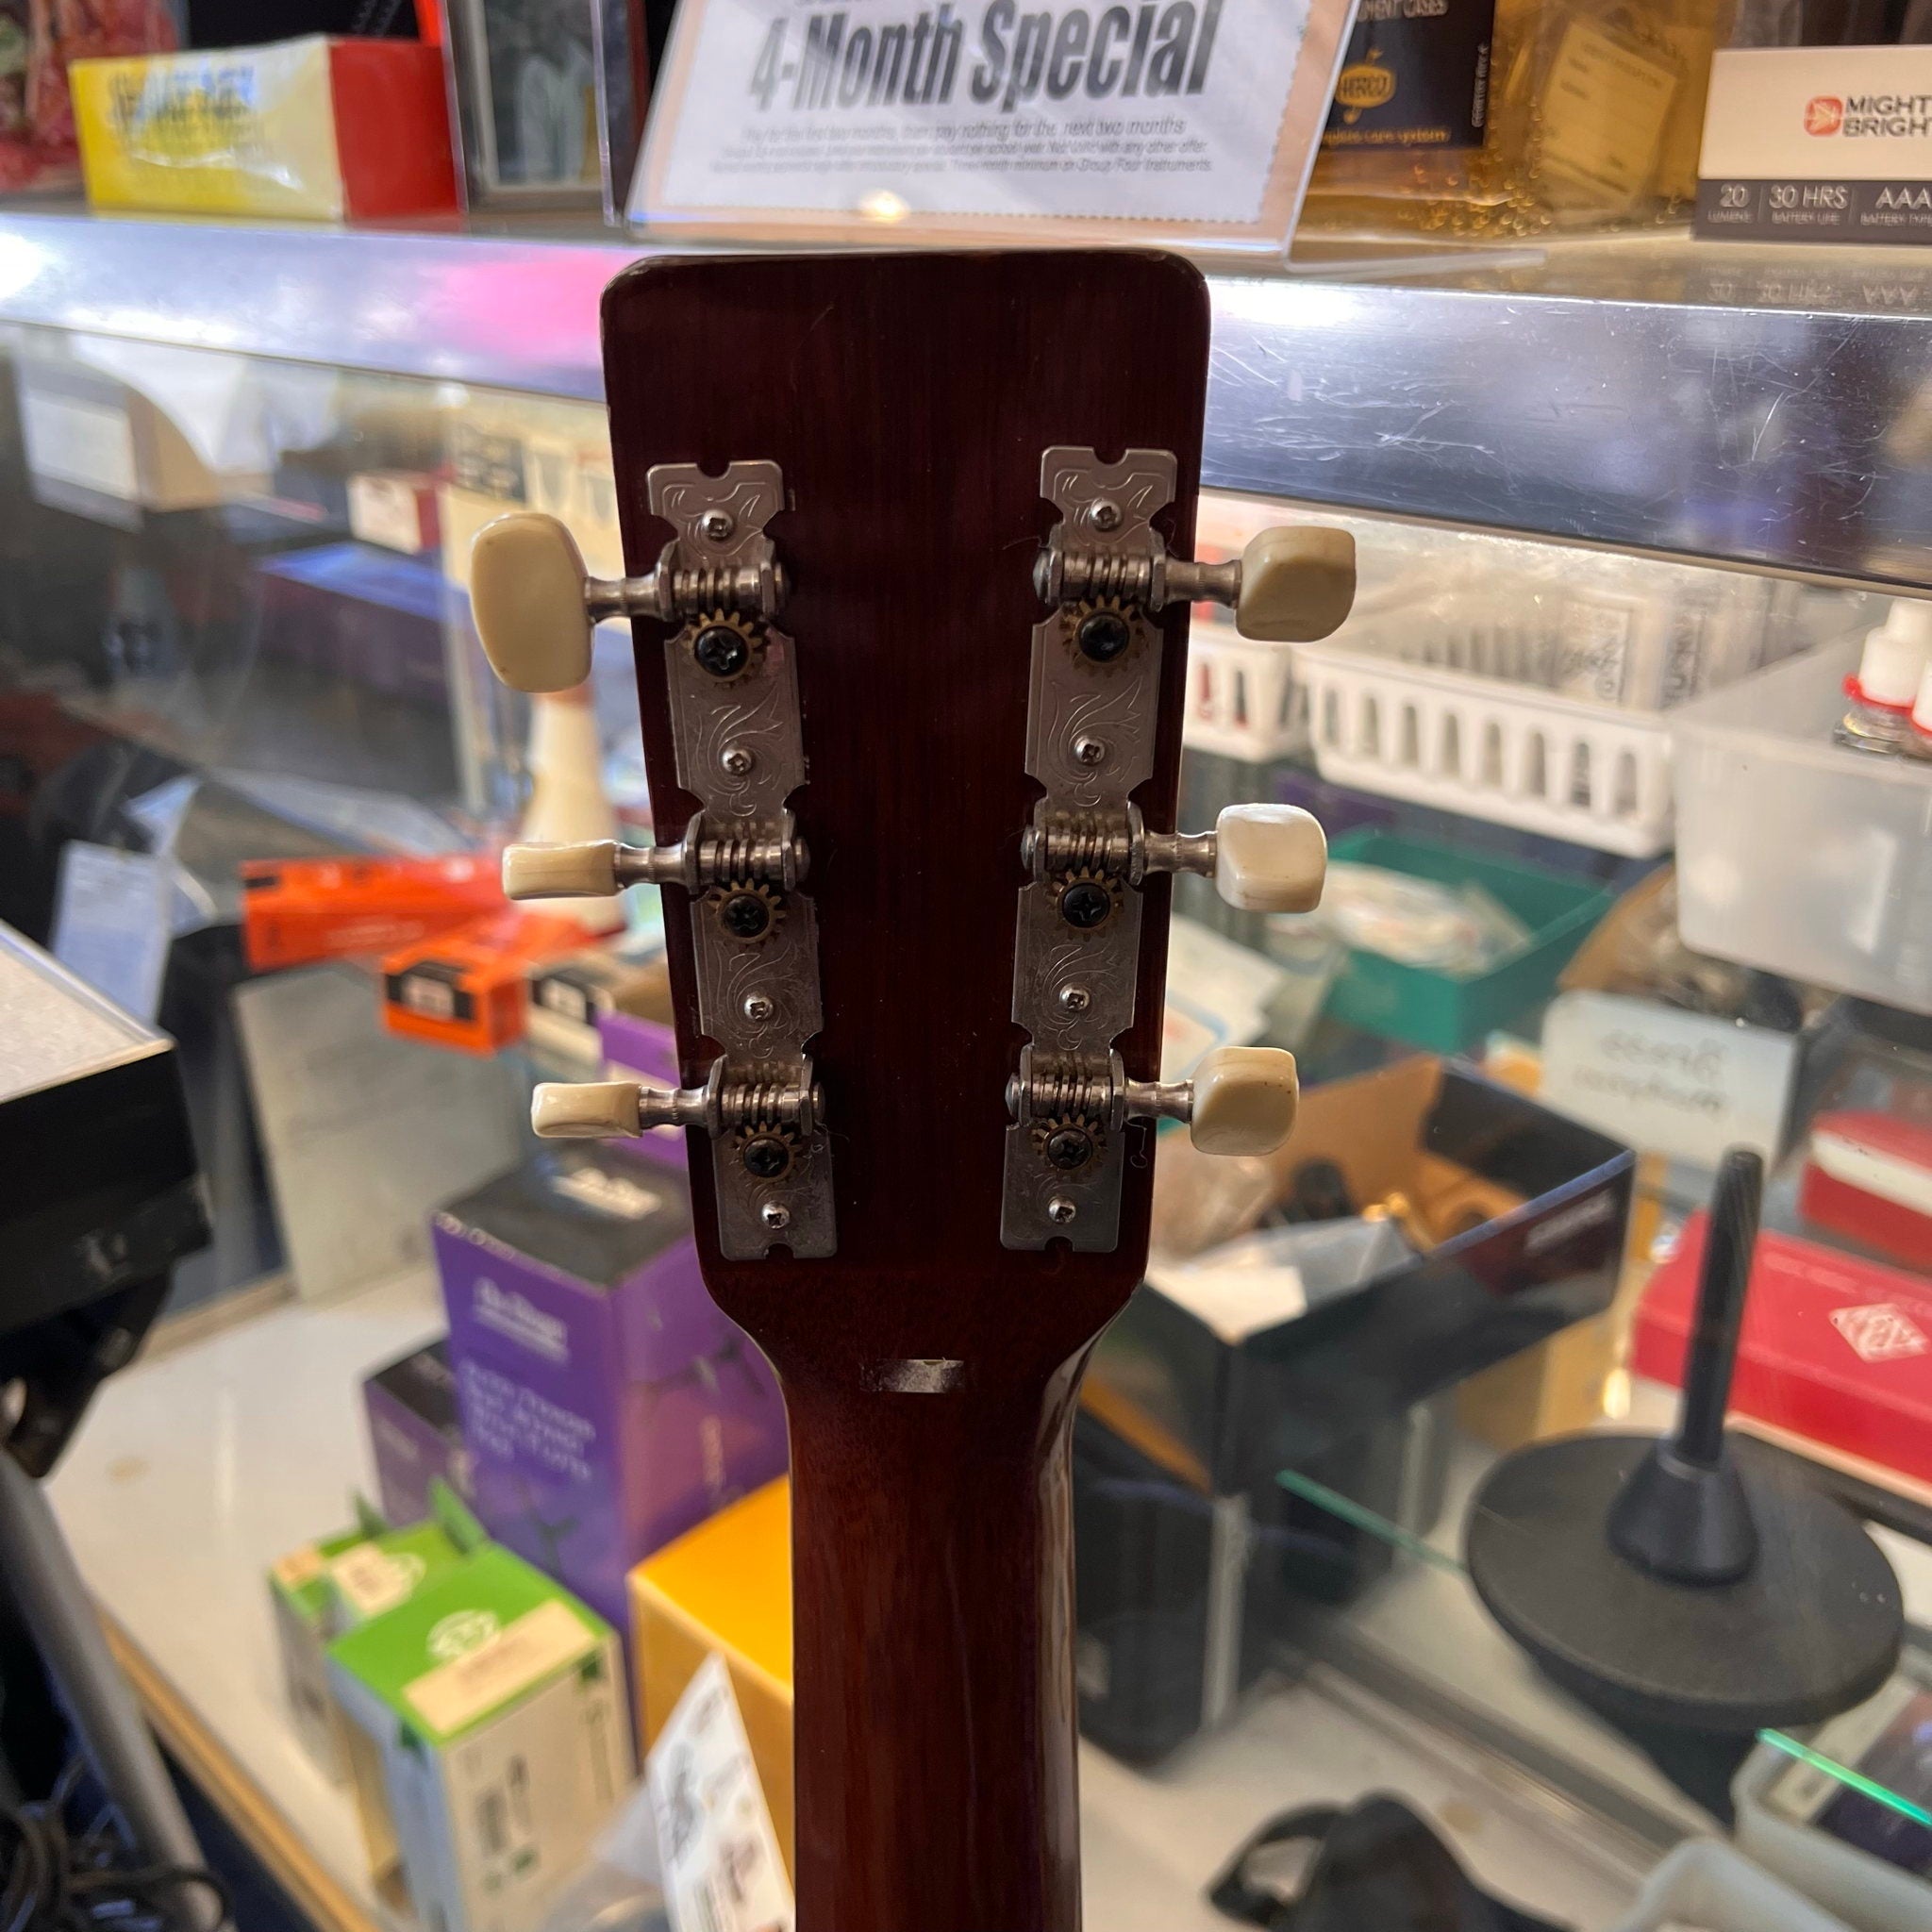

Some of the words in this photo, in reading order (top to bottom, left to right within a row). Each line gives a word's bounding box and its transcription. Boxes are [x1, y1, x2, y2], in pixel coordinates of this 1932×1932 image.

[751, 11, 962, 112] 4-Month
[970, 0, 1224, 112] Special
[1720, 184, 1750, 208] 20
[1769, 185, 1798, 208] 30
[1802, 185, 1849, 209] HRS
[1874, 187, 1932, 210] AAA
